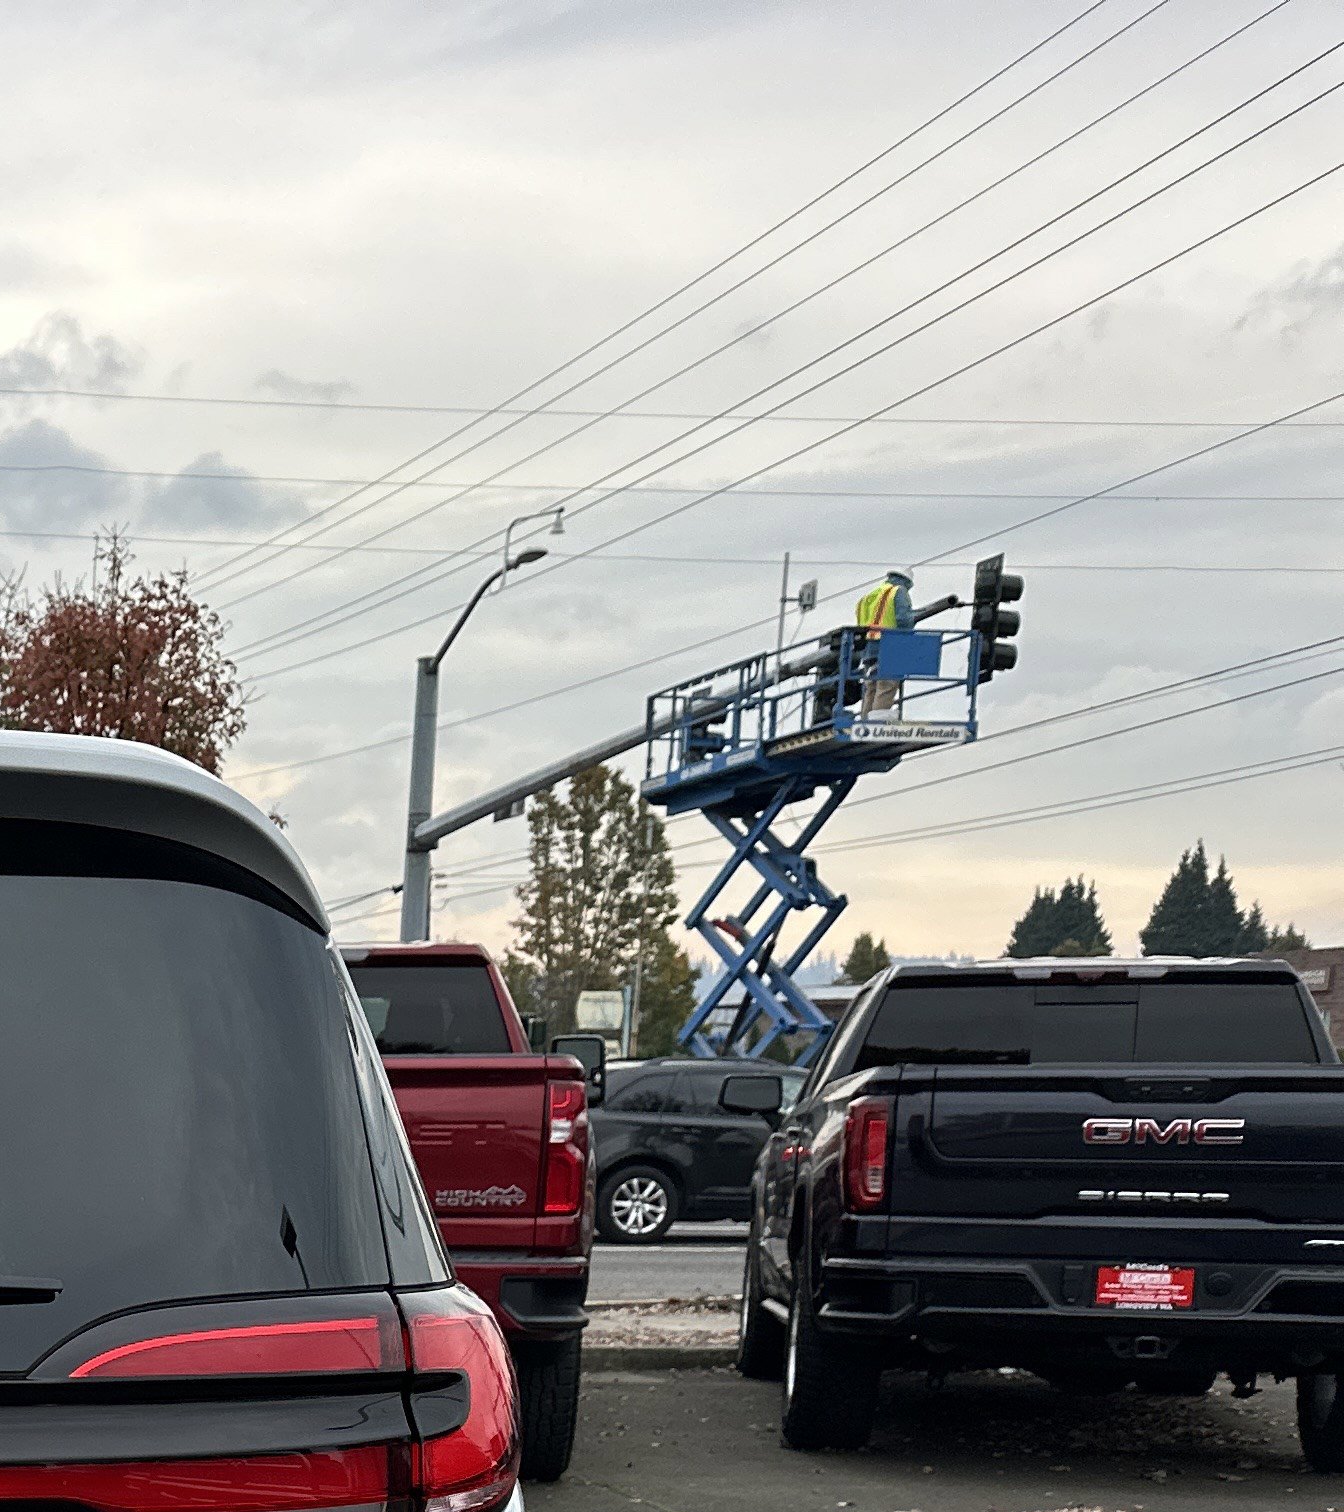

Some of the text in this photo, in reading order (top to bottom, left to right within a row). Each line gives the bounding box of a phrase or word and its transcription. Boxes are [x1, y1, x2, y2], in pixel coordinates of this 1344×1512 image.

[872, 727, 960, 738] United Rentals
[1082, 1118, 1245, 1144] GMC
